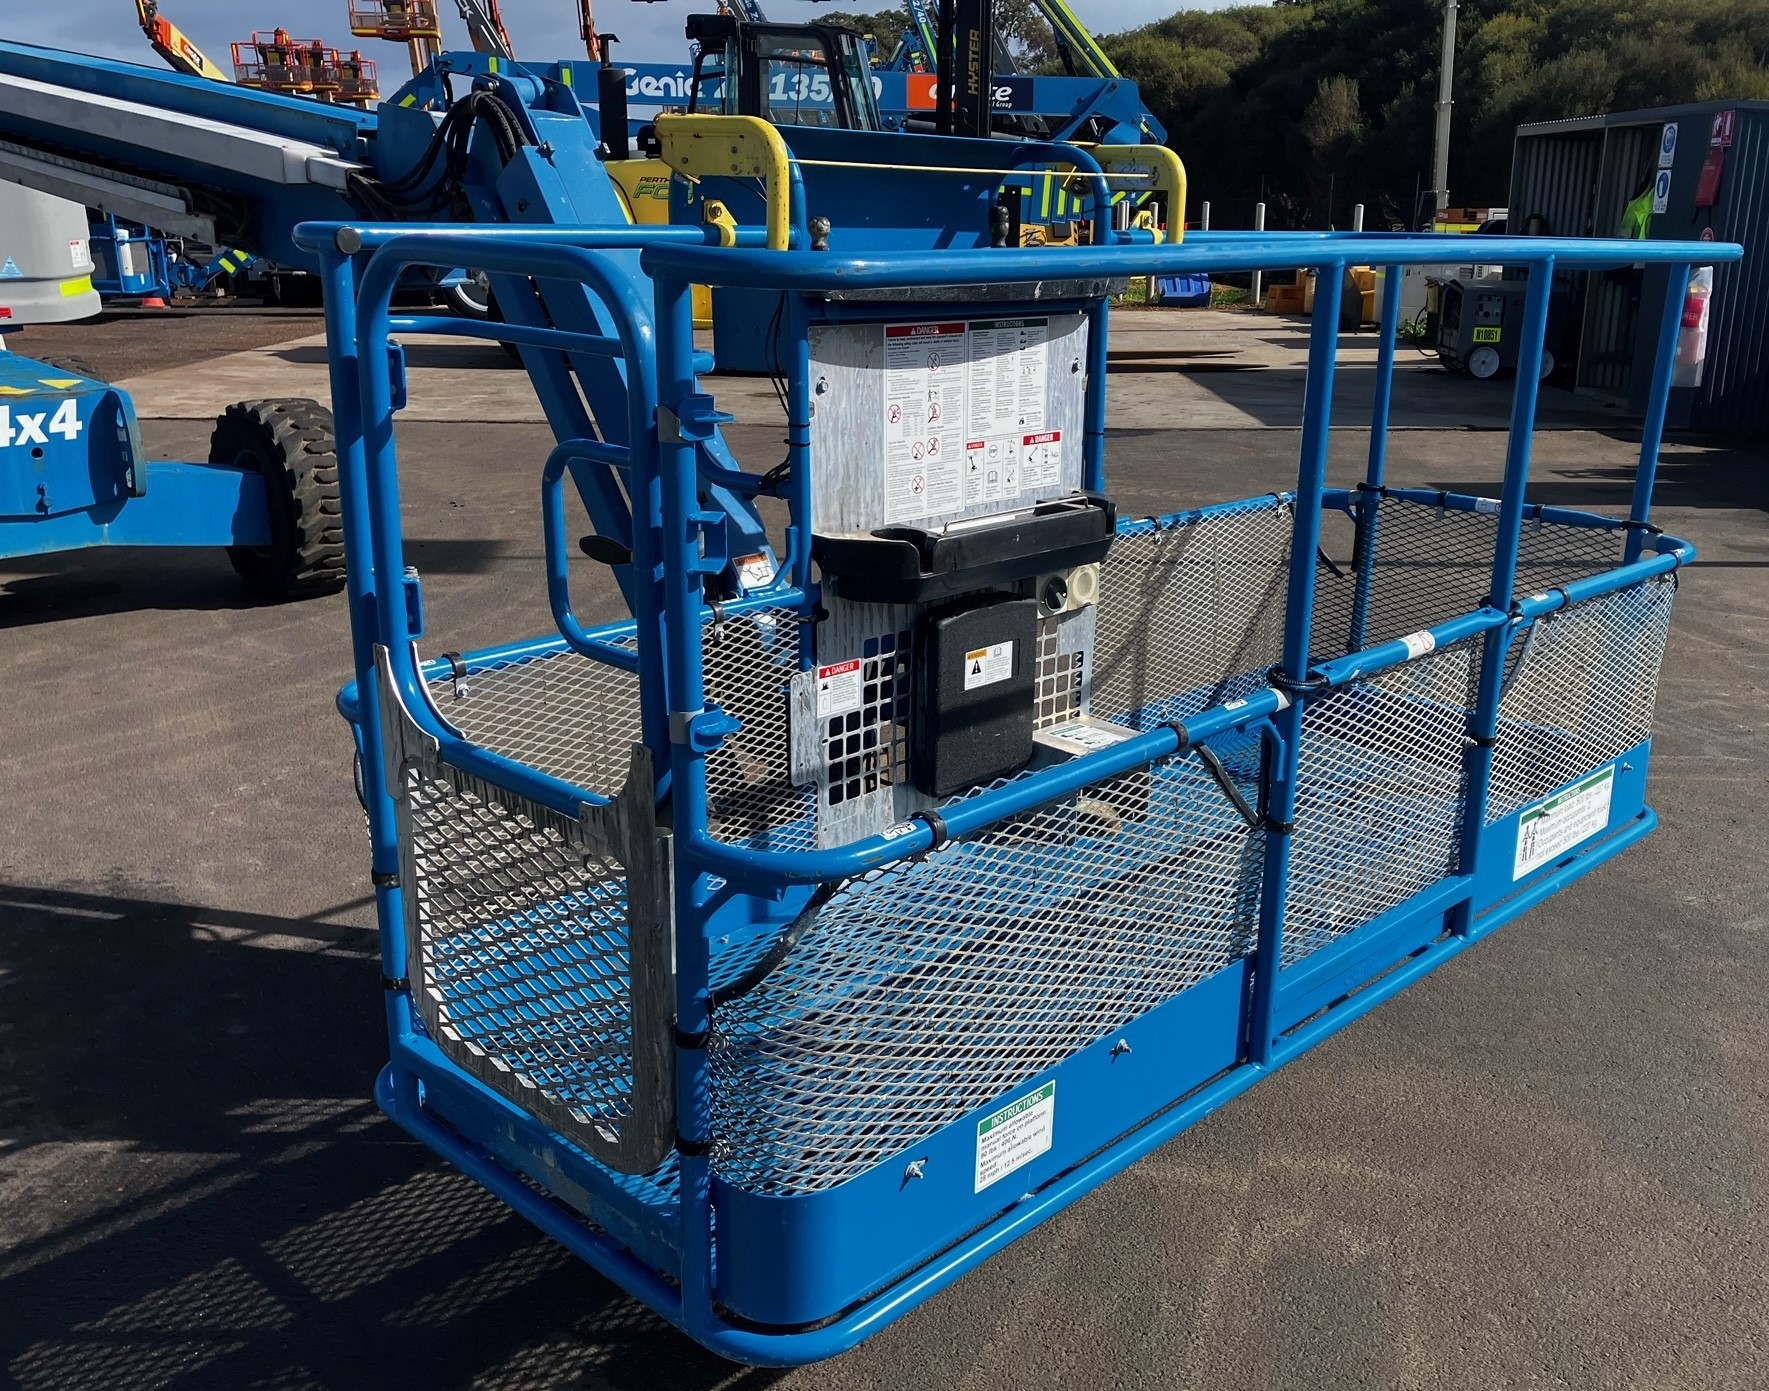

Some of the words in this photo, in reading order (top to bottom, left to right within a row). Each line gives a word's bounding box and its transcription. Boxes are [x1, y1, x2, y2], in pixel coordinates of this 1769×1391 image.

[967, 28, 980, 95] HYSTER
[623, 67, 703, 98] Genie
[916, 325, 939, 335] DANGER
[994, 320, 1025, 328] INSTRUCTIONS
[1035, 433, 1054, 443] DANGER
[831, 662, 854, 675] DANGER
[991, 1090, 1044, 1128] INSTRUCTIONS
[981, 1125, 1008, 1144] Maximum
[1008, 1111, 1034, 1129] allowable
[980, 1149, 1007, 1168] Maximum
[1007, 1135, 1032, 1153] allowable
[1033, 1125, 1046, 1137] wind
[981, 1137, 1001, 1151] manual
[1002, 1128, 1016, 1140] force
[987, 1167, 1000, 1179] mph
